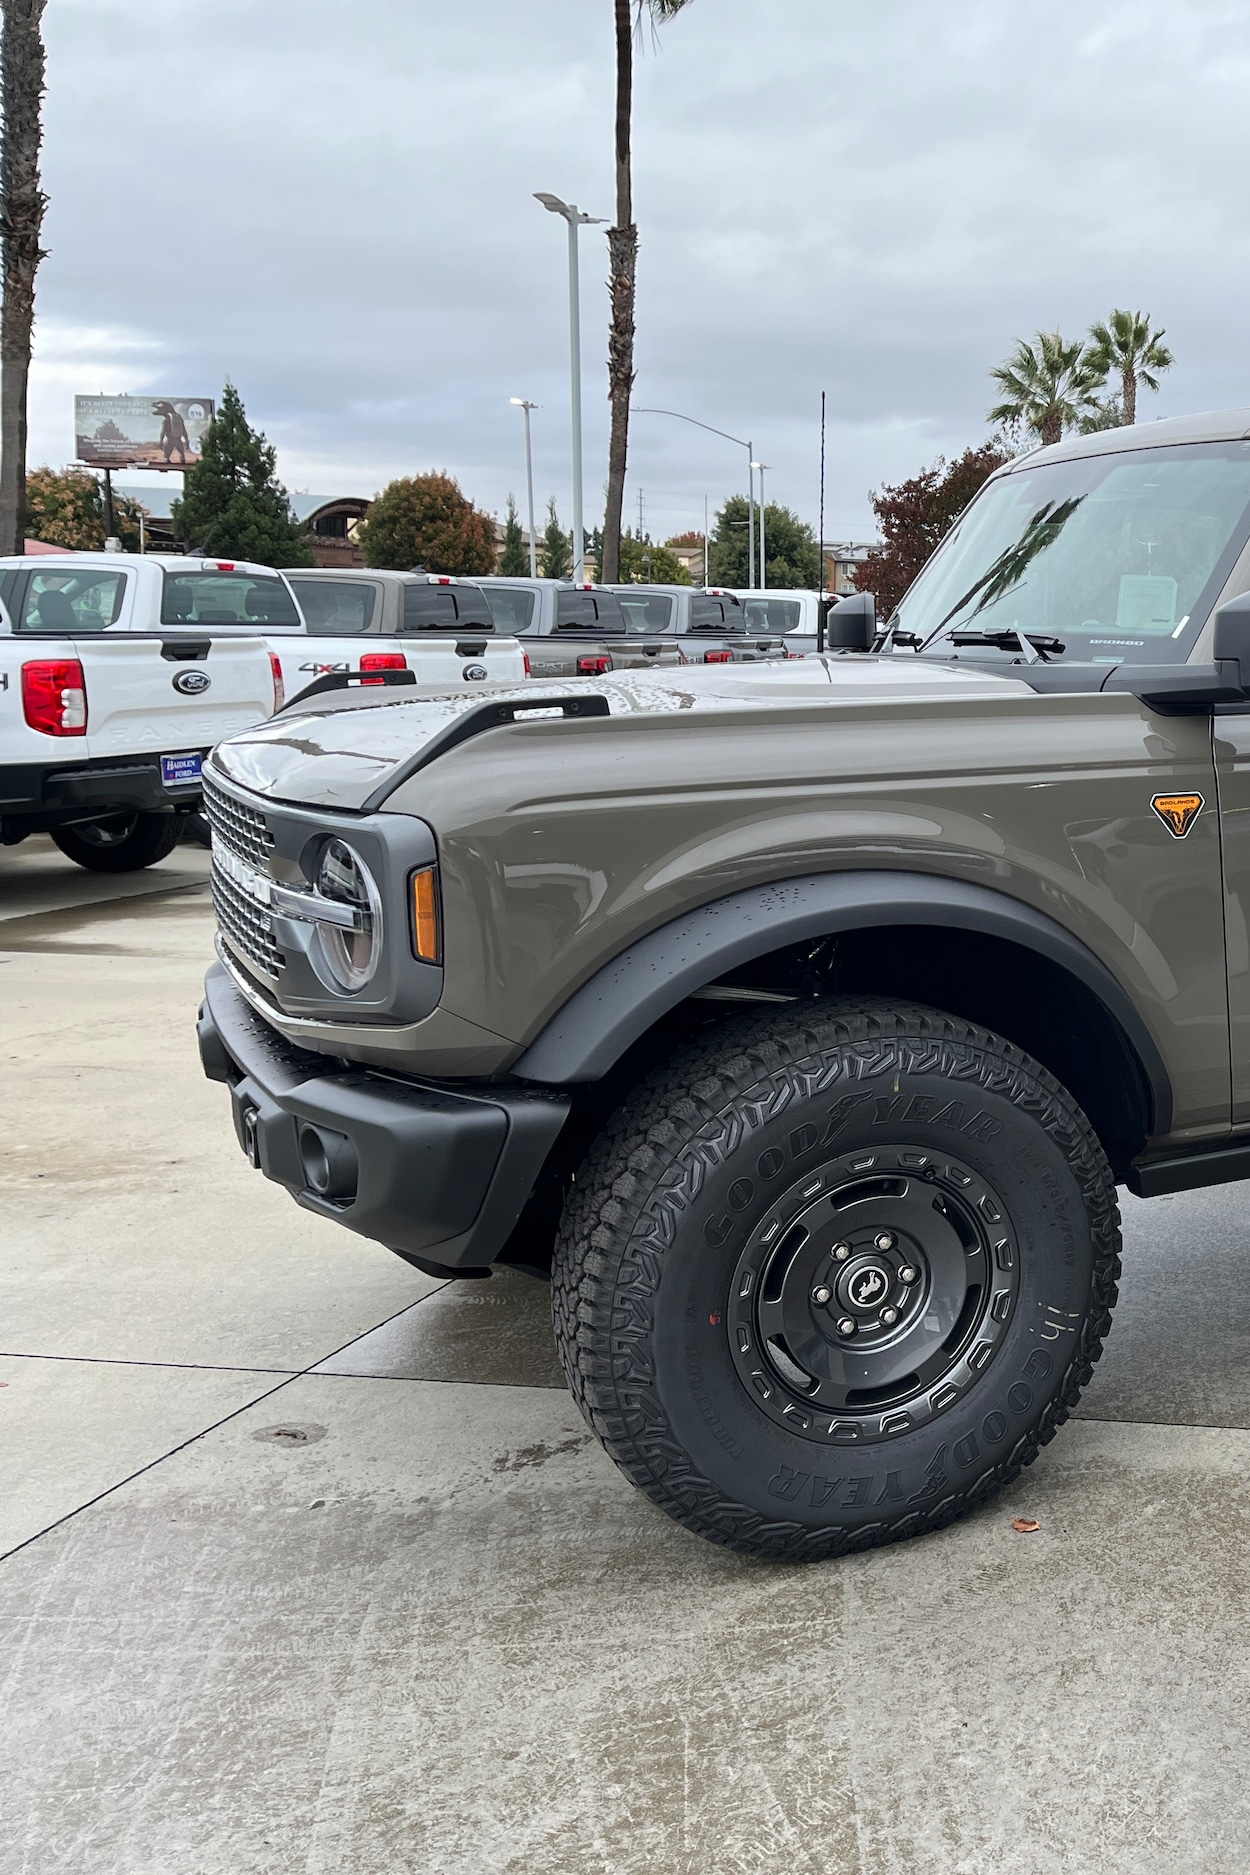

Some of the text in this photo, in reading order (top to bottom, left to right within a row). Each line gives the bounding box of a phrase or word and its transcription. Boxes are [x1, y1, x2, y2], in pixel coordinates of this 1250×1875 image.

[529, 661, 568, 674] PORT
[166, 760, 196, 771] HAIDLEN
[175, 769, 193, 778] FORD
[702, 1088, 1004, 1249] GOODYEAR
[767, 1348, 1054, 1509] GOODYEAR
